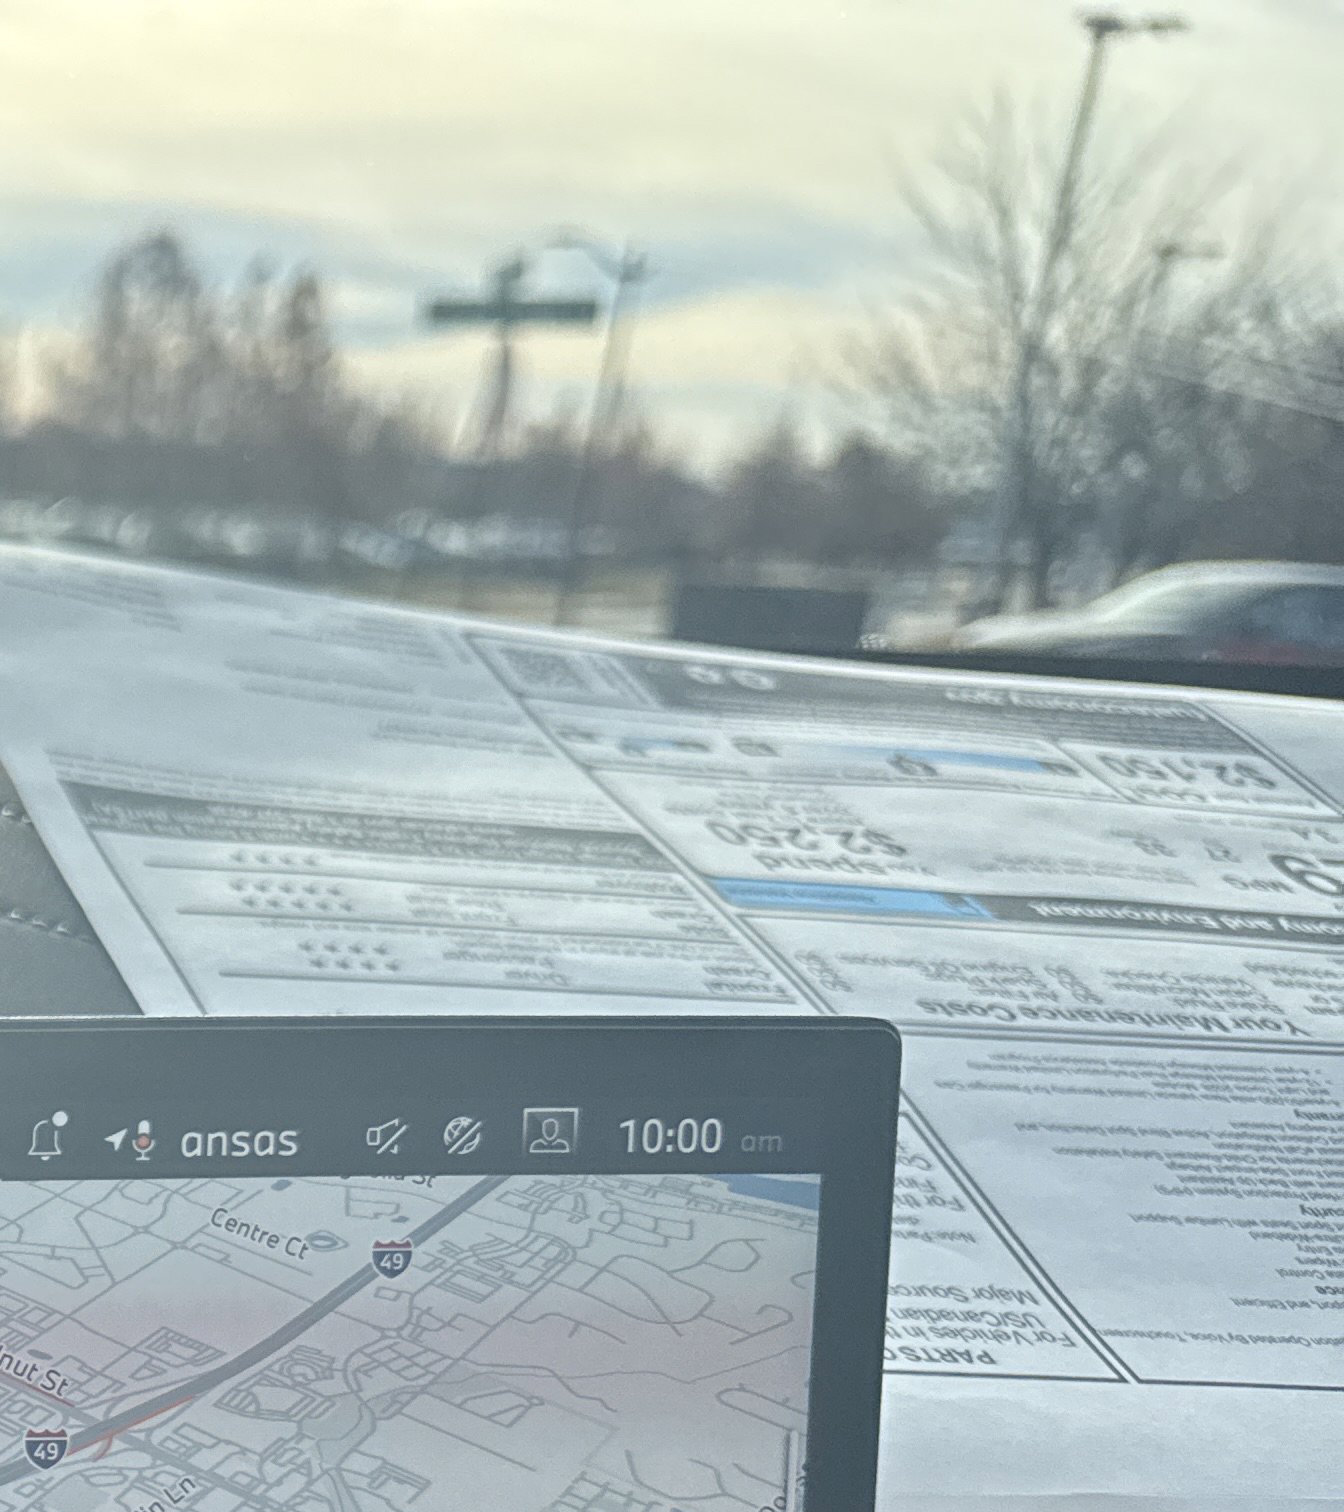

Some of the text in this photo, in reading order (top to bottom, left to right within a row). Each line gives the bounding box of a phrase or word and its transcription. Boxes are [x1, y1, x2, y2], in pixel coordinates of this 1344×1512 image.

[704, 820, 908, 858] $2,250
[1027, 901, 1217, 929] Environment
[915, 999, 1313, 1038] Your Maintenance Costs
[180, 1128, 300, 1160] ansas
[618, 1118, 785, 1155] 10:00 am
[209, 1206, 311, 1261] Centre Ct
[379, 1250, 405, 1272] 49
[970, 1284, 1041, 1307] Major
[890, 1307, 1047, 1329] US/Canadian
[905, 1325, 929, 1341] in
[932, 1324, 1030, 1347] Vehicles
[1029, 1329, 1078, 1349] For
[898, 1345, 997, 1365] PARTS
[38, 1368, 70, 1398] St
[32, 1439, 61, 1464] 49
[160, 1474, 198, 1510] Ln
